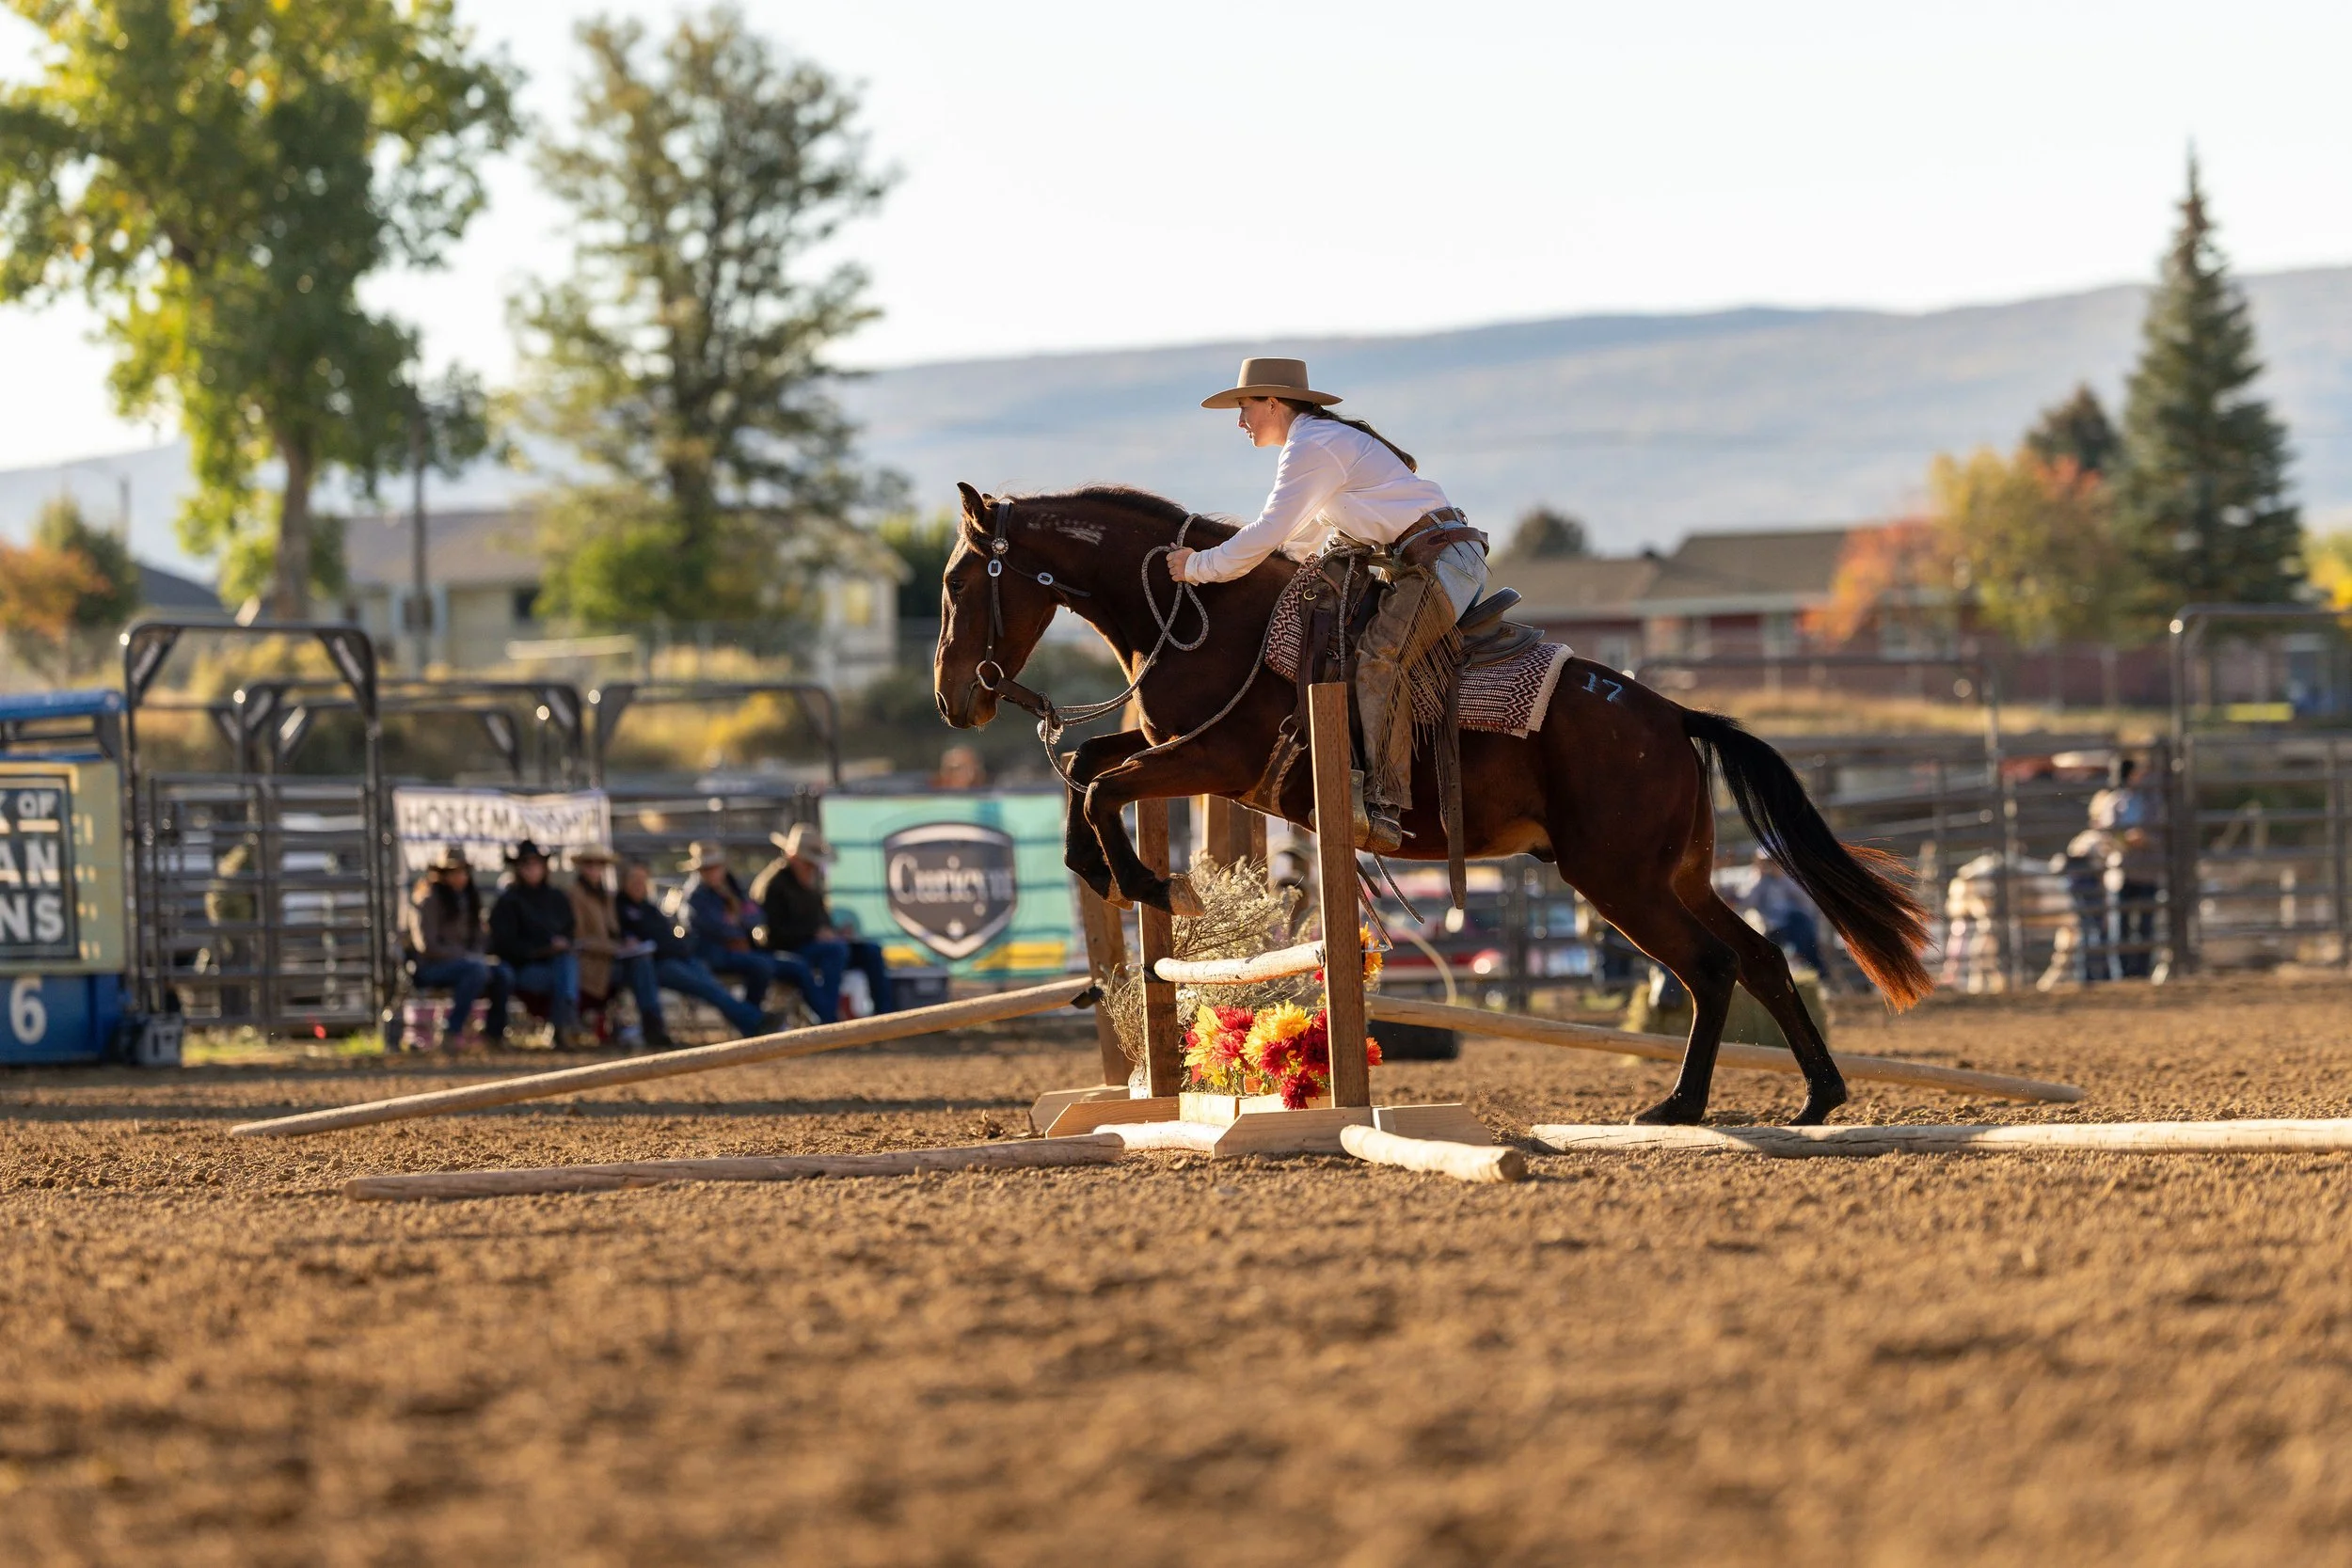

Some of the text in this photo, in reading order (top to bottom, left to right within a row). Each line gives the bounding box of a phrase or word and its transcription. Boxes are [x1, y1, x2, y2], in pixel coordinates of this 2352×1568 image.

[1581, 671, 1624, 702] 17
[17, 791, 58, 817] OF
[0, 894, 65, 942] NS
[9, 976, 46, 1045] 6
